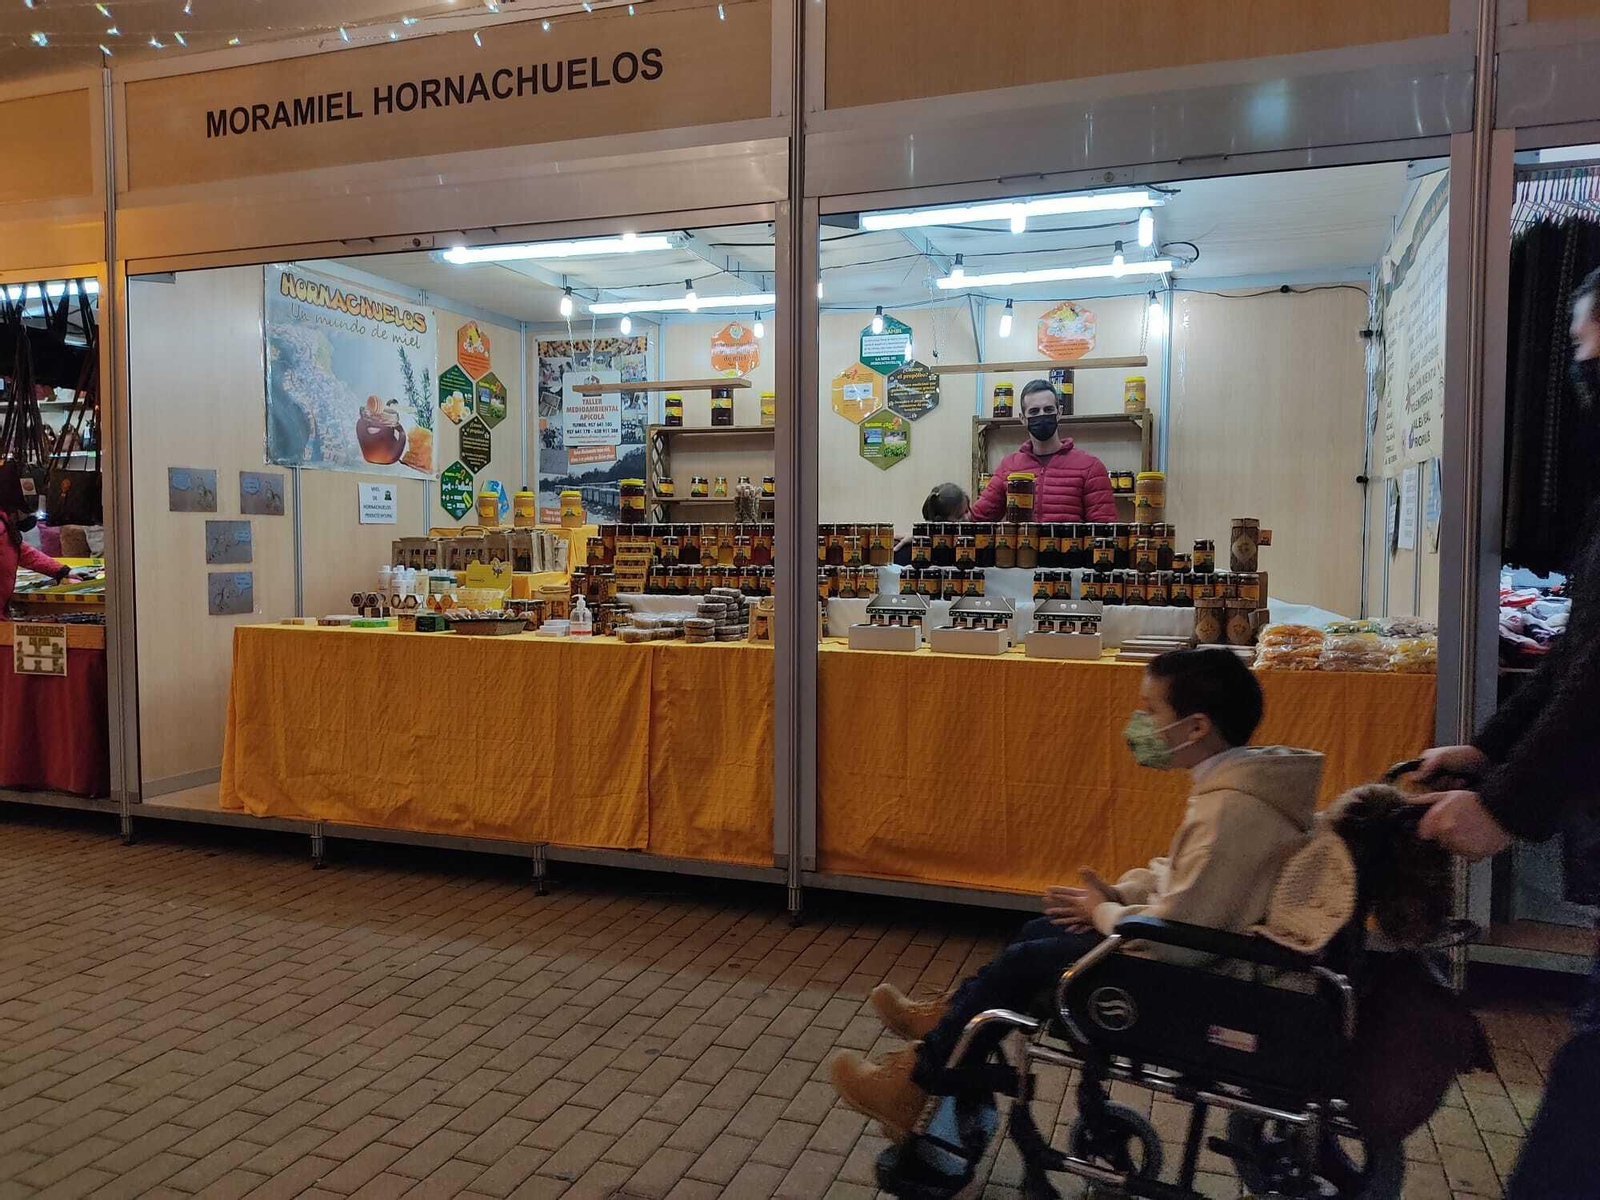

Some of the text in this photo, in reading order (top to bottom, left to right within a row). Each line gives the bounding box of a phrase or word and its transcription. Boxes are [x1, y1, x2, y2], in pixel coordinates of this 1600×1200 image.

[205, 47, 664, 138] MORAMIEL HORNACHUELOS
[280, 272, 428, 334] HORNACHUELOS
[290, 303, 421, 350] Un mundo de miel
[566, 405, 619, 413] MEDIOAMBIENTAL
[582, 398, 603, 406] TALLER
[16, 625, 65, 638] MONEDEROS
